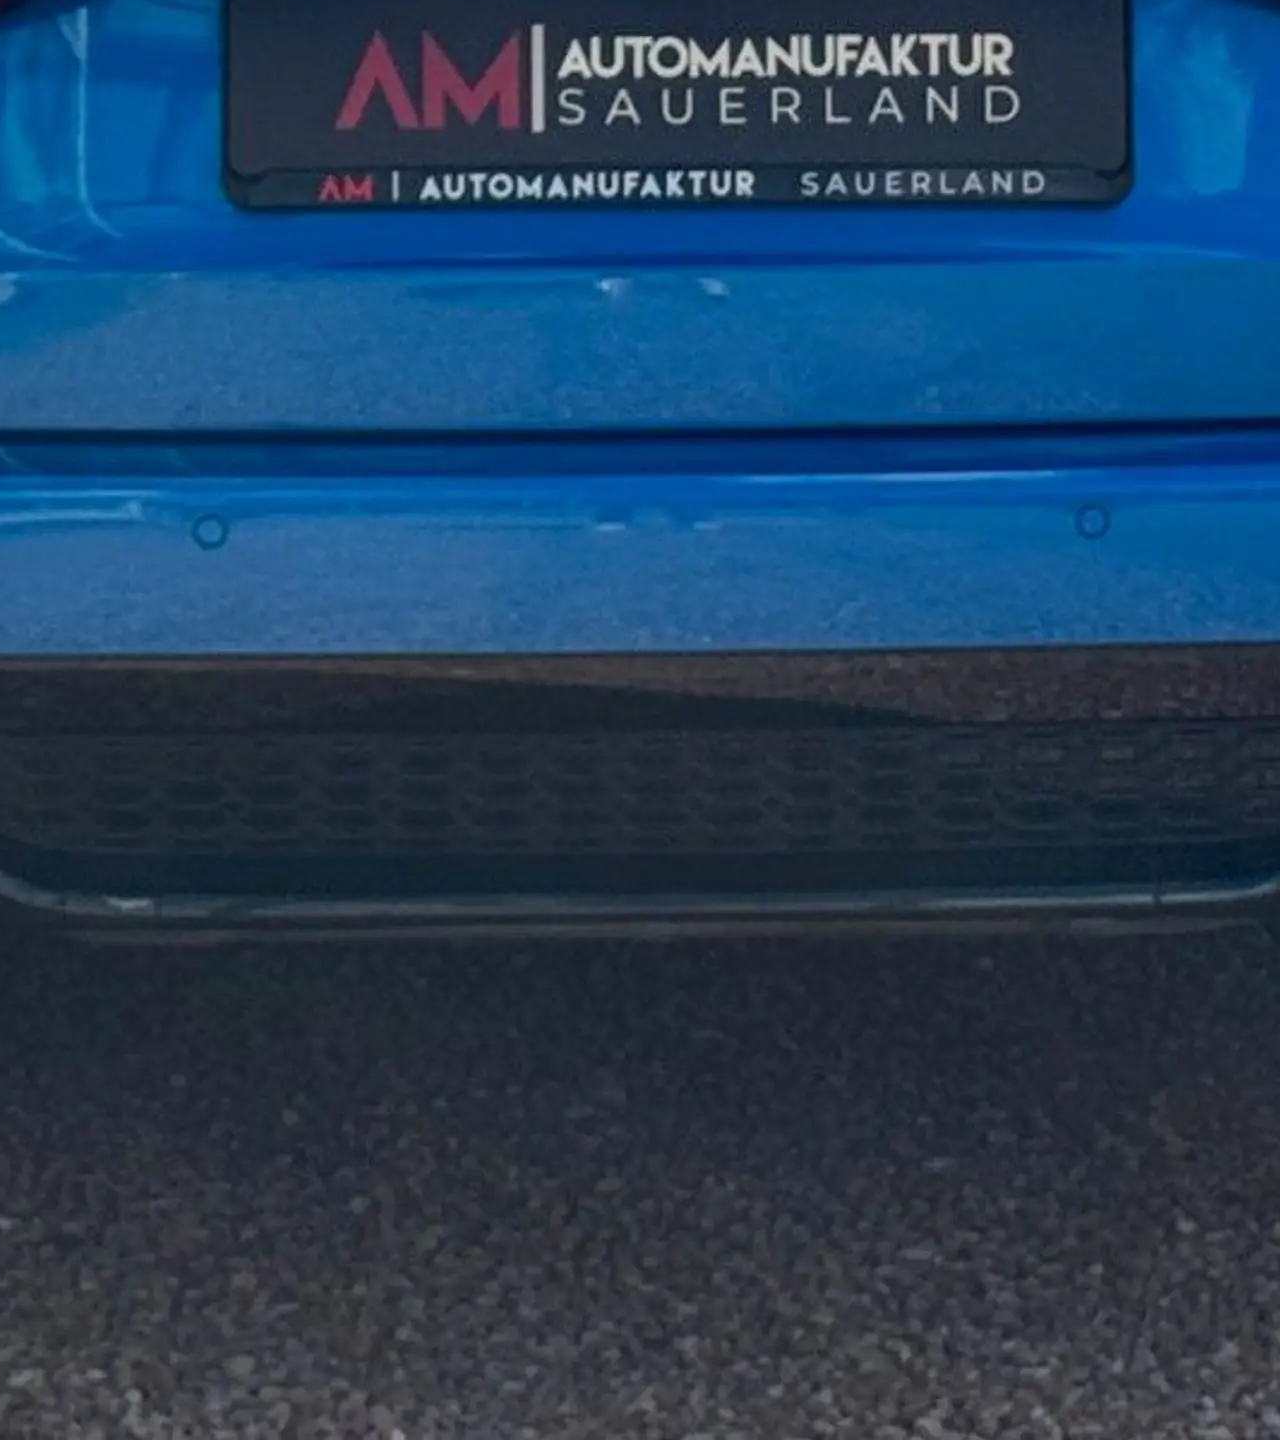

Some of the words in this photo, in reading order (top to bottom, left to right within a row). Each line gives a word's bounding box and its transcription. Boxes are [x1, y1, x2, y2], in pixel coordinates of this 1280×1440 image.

[557, 32, 1014, 79] AUTOMANUFAKTUR
[334, 31, 521, 131] AM
[557, 85, 1020, 126] SAUERLAND
[319, 175, 375, 201] AM
[420, 170, 755, 201] AUTOMANUFAKTUR
[801, 169, 1046, 197] SAUERLAND
